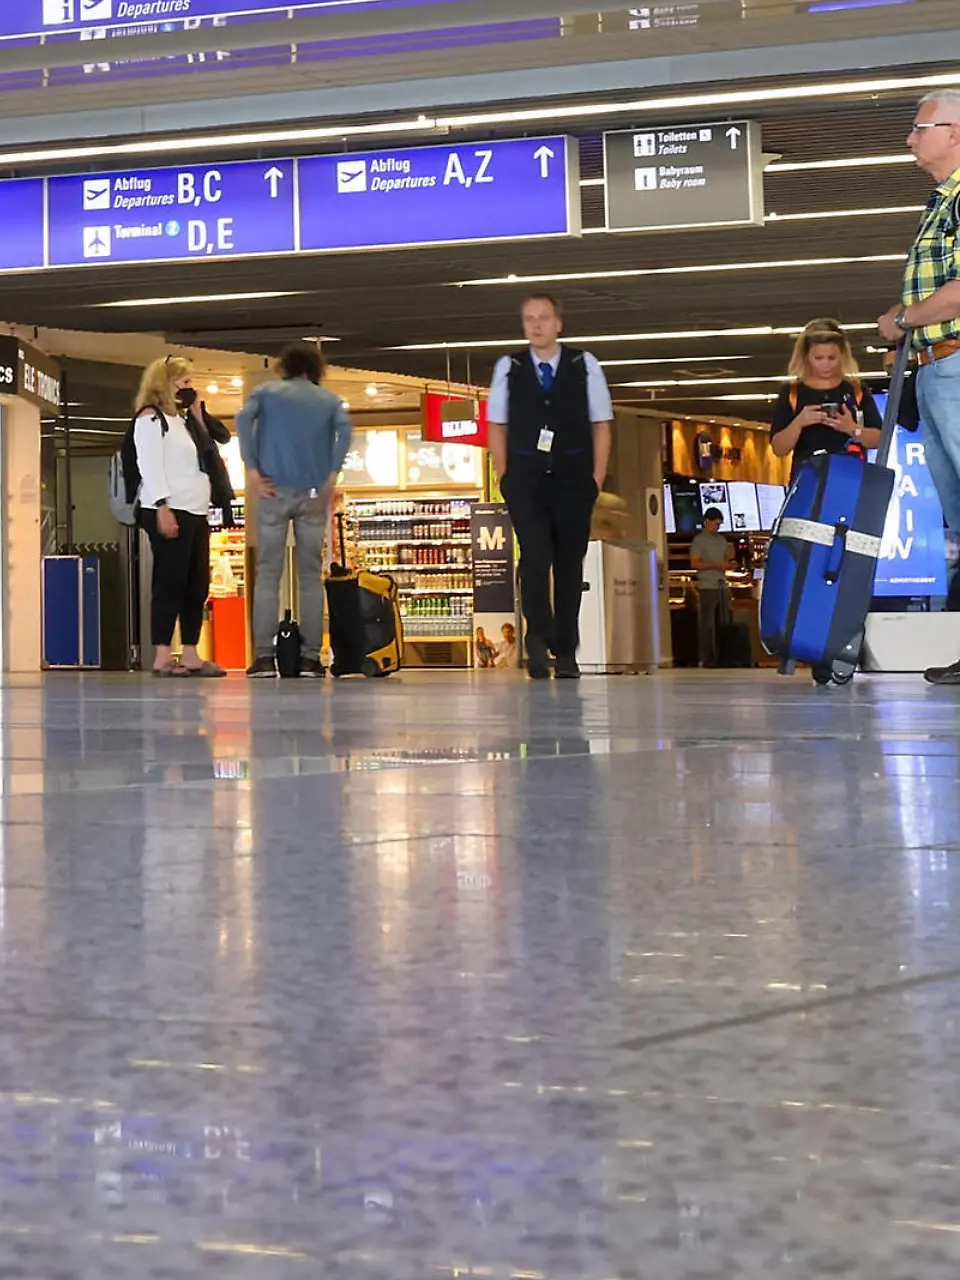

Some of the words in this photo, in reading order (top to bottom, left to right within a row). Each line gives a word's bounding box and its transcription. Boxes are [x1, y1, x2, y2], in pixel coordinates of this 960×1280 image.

[658, 131, 697, 142] Toiletten
[658, 144, 688, 155] Toilets
[370, 158, 410, 173] Abflug
[370, 175, 436, 192] Departures
[443, 150, 494, 188] A,Z
[114, 177, 151, 192] Abflug
[114, 194, 174, 211] Departures
[177, 170, 222, 207] B,C
[114, 223, 162, 239] Terminal
[188, 218, 234, 254] D,E
